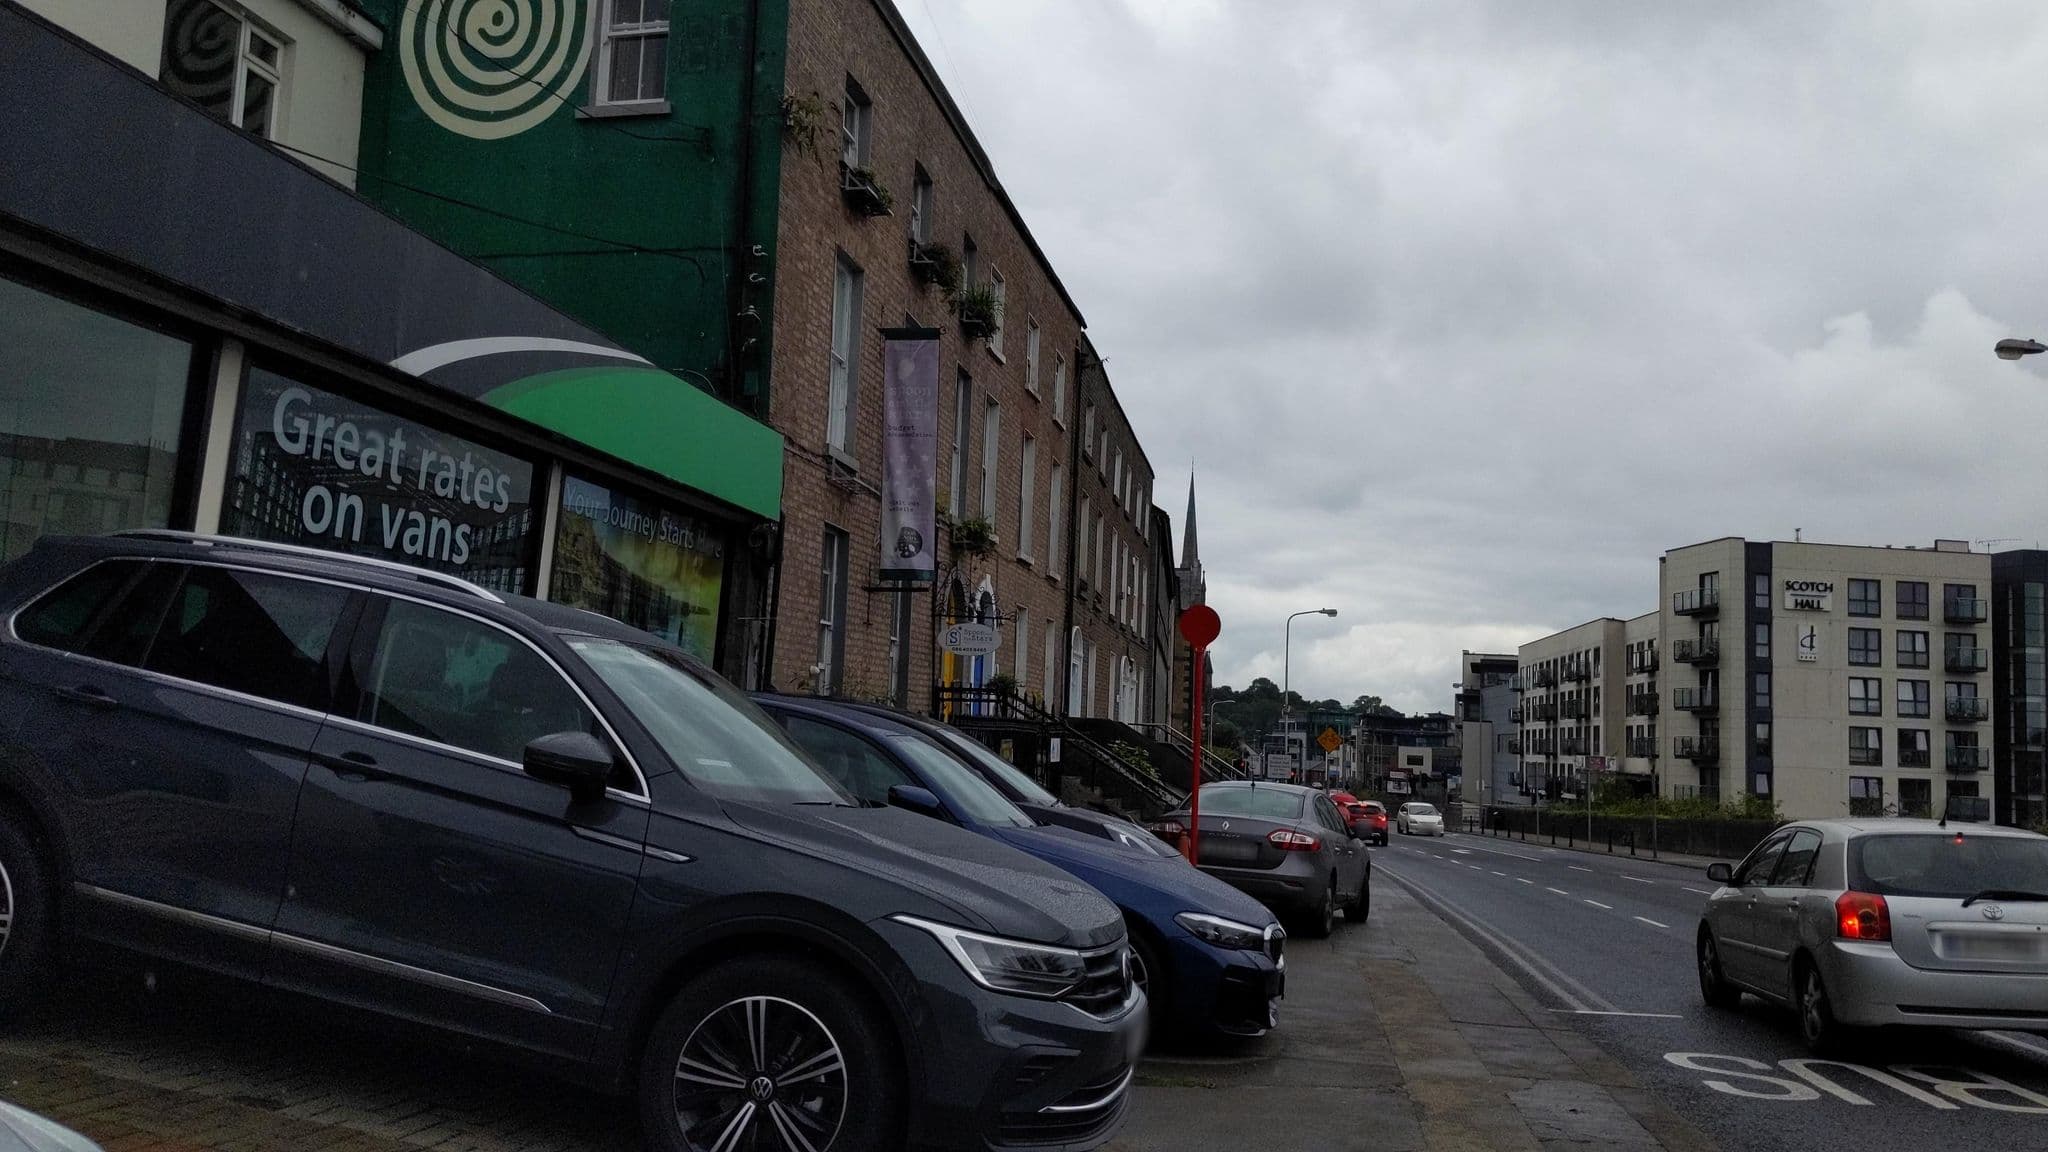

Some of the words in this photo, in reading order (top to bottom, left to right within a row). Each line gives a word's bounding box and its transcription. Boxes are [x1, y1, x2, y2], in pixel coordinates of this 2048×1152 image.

[273, 387, 407, 485] Great
[418, 447, 511, 514] rates
[302, 485, 364, 543] on
[381, 502, 471, 565] vans
[565, 484, 600, 518] Your
[604, 504, 658, 544] Journey
[660, 516, 694, 549] Starts
[698, 528, 722, 558] He
[1785, 581, 1833, 592] SCOTCH
[1795, 598, 1824, 609] HALL
[950, 631, 958, 644] S
[1663, 1052, 2048, 1114] BUS
